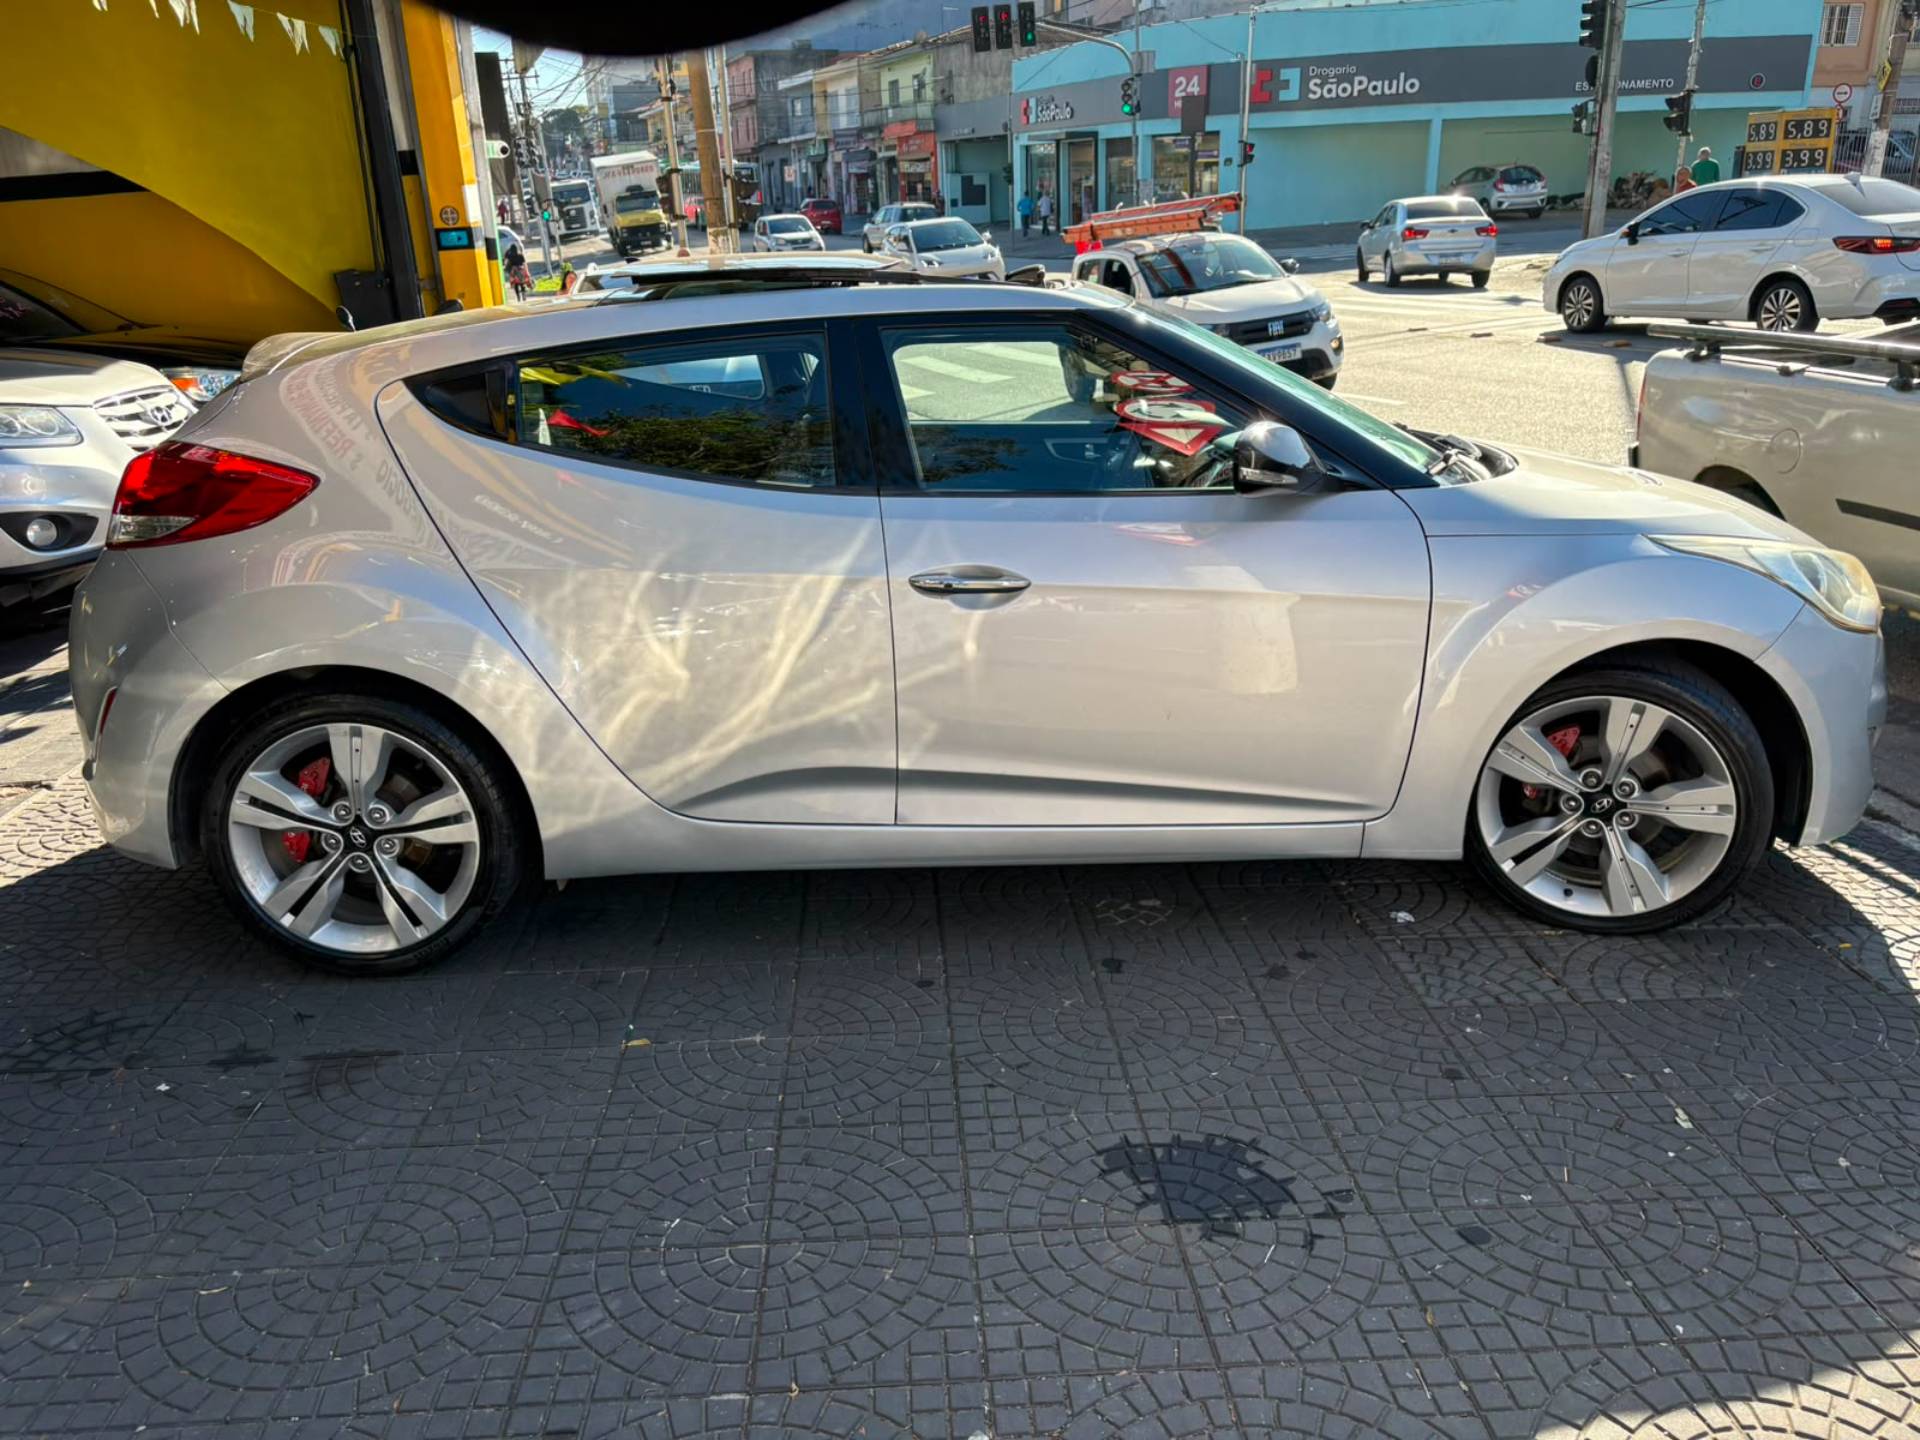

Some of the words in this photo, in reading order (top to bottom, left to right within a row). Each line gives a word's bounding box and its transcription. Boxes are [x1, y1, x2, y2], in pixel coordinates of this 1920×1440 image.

[1308, 65, 1357, 79] Drogaria
[1174, 75, 1200, 97] 24
[1307, 71, 1421, 100] SãoPaulo
[1749, 123, 1776, 142] 5,89
[1787, 119, 1829, 140] 5,89
[1784, 149, 1824, 168] 3,99
